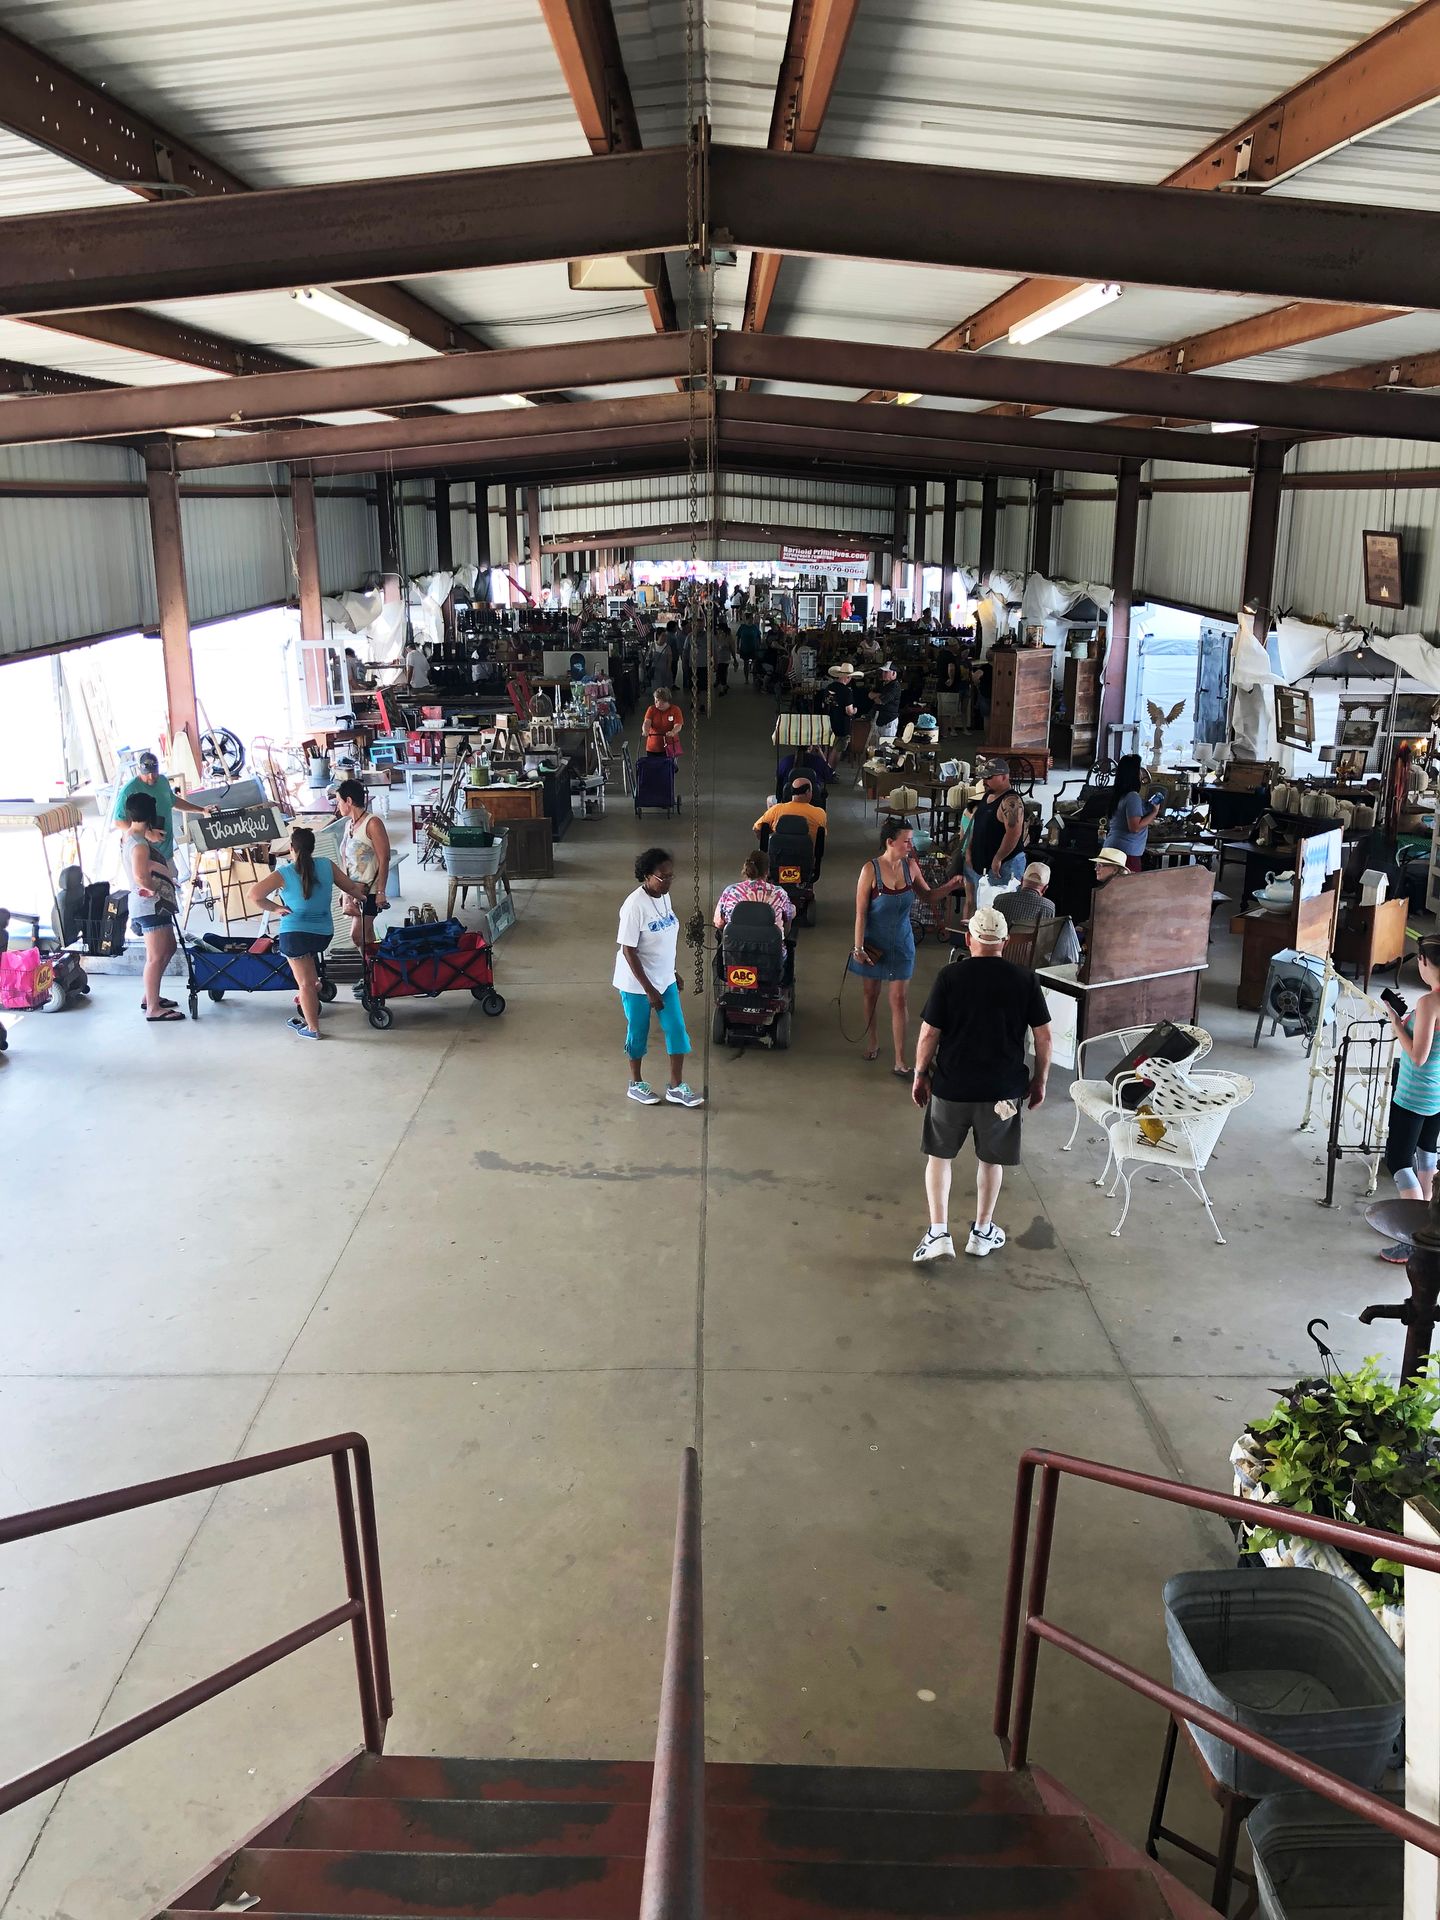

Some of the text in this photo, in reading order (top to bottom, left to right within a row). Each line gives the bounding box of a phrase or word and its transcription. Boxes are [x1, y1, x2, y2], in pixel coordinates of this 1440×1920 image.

[813, 549, 866, 559] Primitives.com
[205, 815, 270, 839] thankful
[37, 968, 51, 985] ABC
[732, 971, 753, 980] ABC
